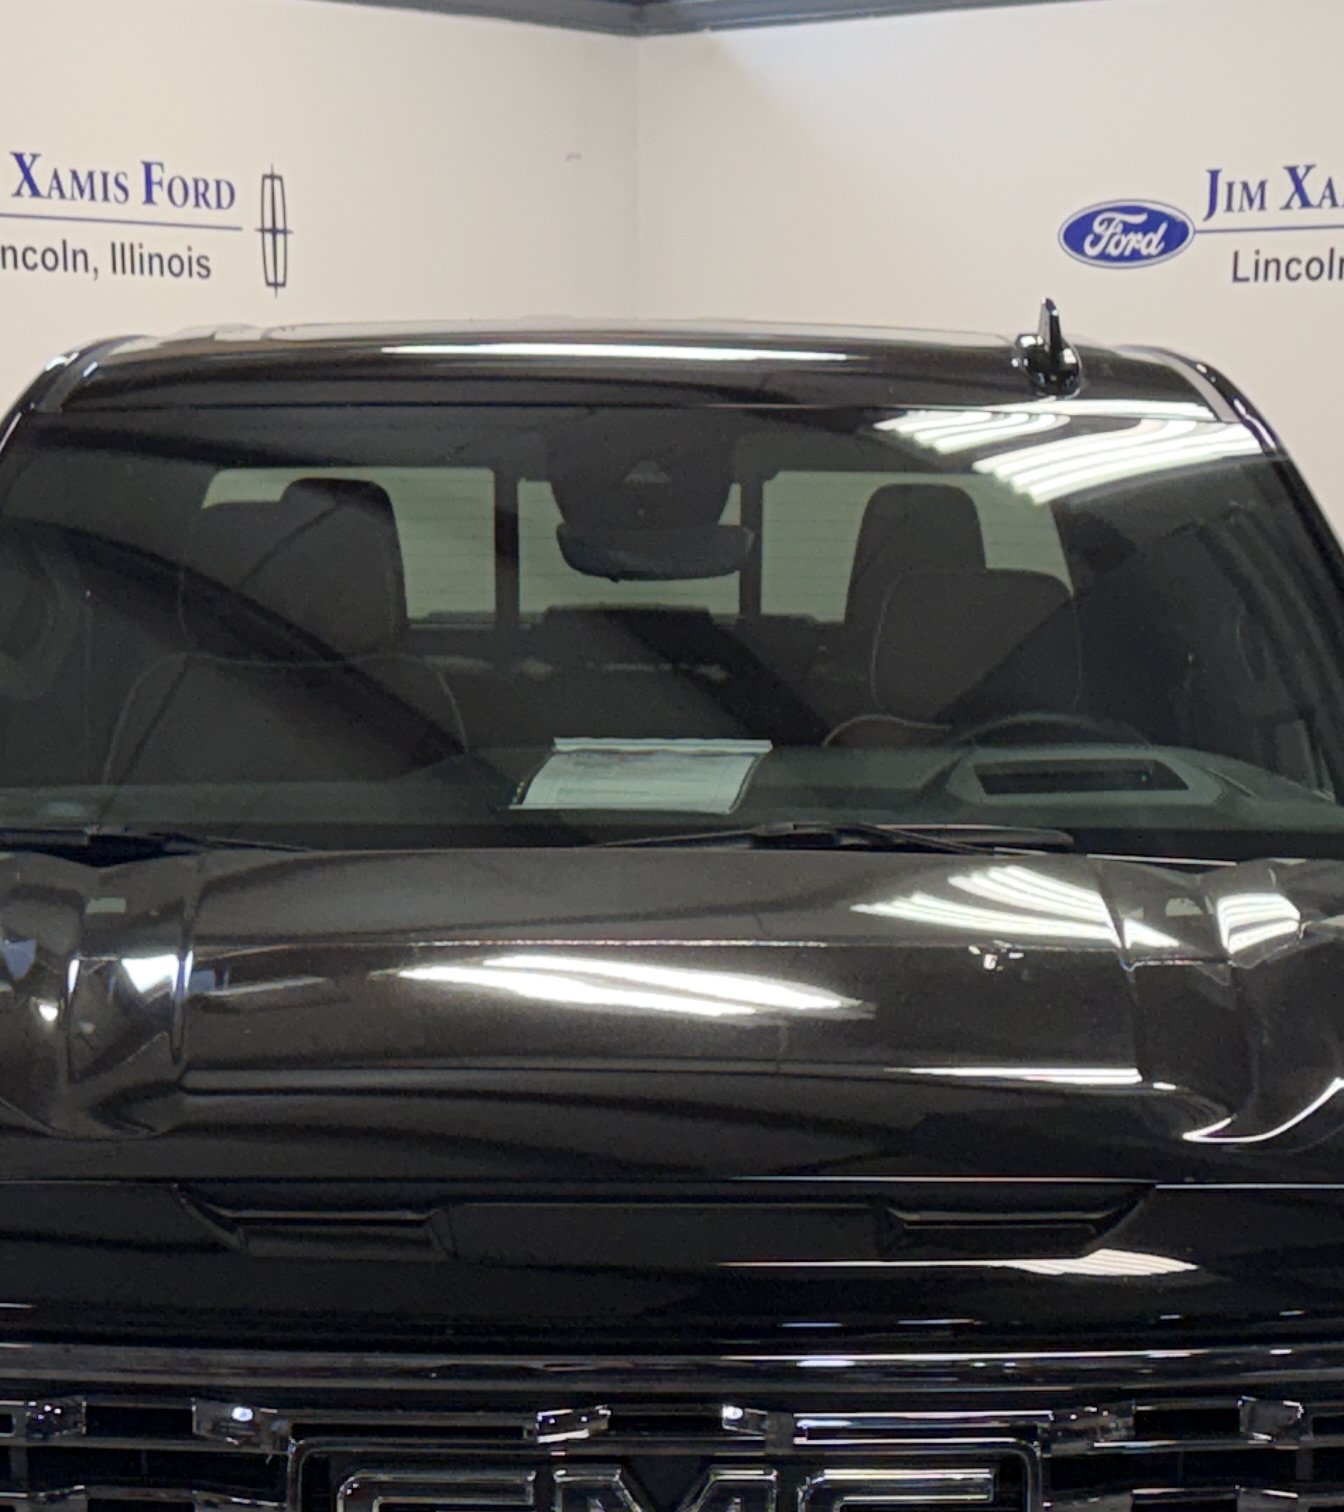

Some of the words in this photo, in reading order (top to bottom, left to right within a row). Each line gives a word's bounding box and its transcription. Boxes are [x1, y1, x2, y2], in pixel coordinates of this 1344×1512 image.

[10, 151, 129, 204] XAMIS
[140, 160, 236, 211] FORD
[1203, 168, 1268, 221] JIM
[1083, 213, 1165, 257] Ford
[110, 241, 212, 280] Illinois
